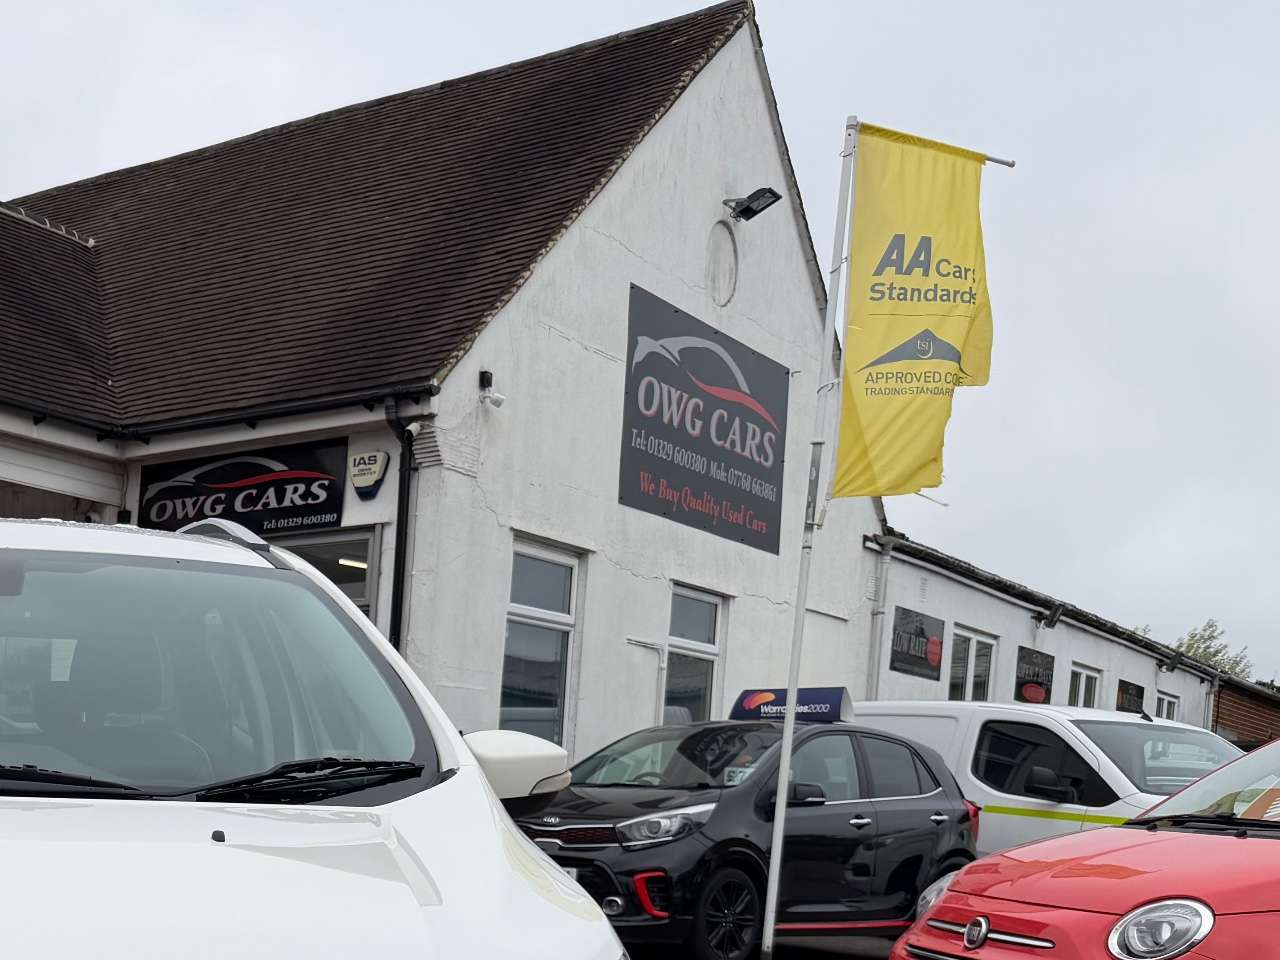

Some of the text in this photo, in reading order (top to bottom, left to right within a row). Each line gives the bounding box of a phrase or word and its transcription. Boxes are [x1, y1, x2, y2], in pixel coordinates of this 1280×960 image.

[872, 233, 932, 277] AA
[865, 371, 942, 384] APPROVED
[637, 376, 776, 468] OWG CARS
[352, 455, 377, 468] IAS
[631, 428, 646, 451] Tel:
[647, 436, 673, 461] 01329
[674, 446, 707, 474] 600380
[150, 480, 329, 522] OWG CARS
[263, 513, 337, 530] Tel: 01329 600380
[640, 471, 768, 534] We Buy Quality Used Cars
[761, 703, 830, 713] Warraies2000
